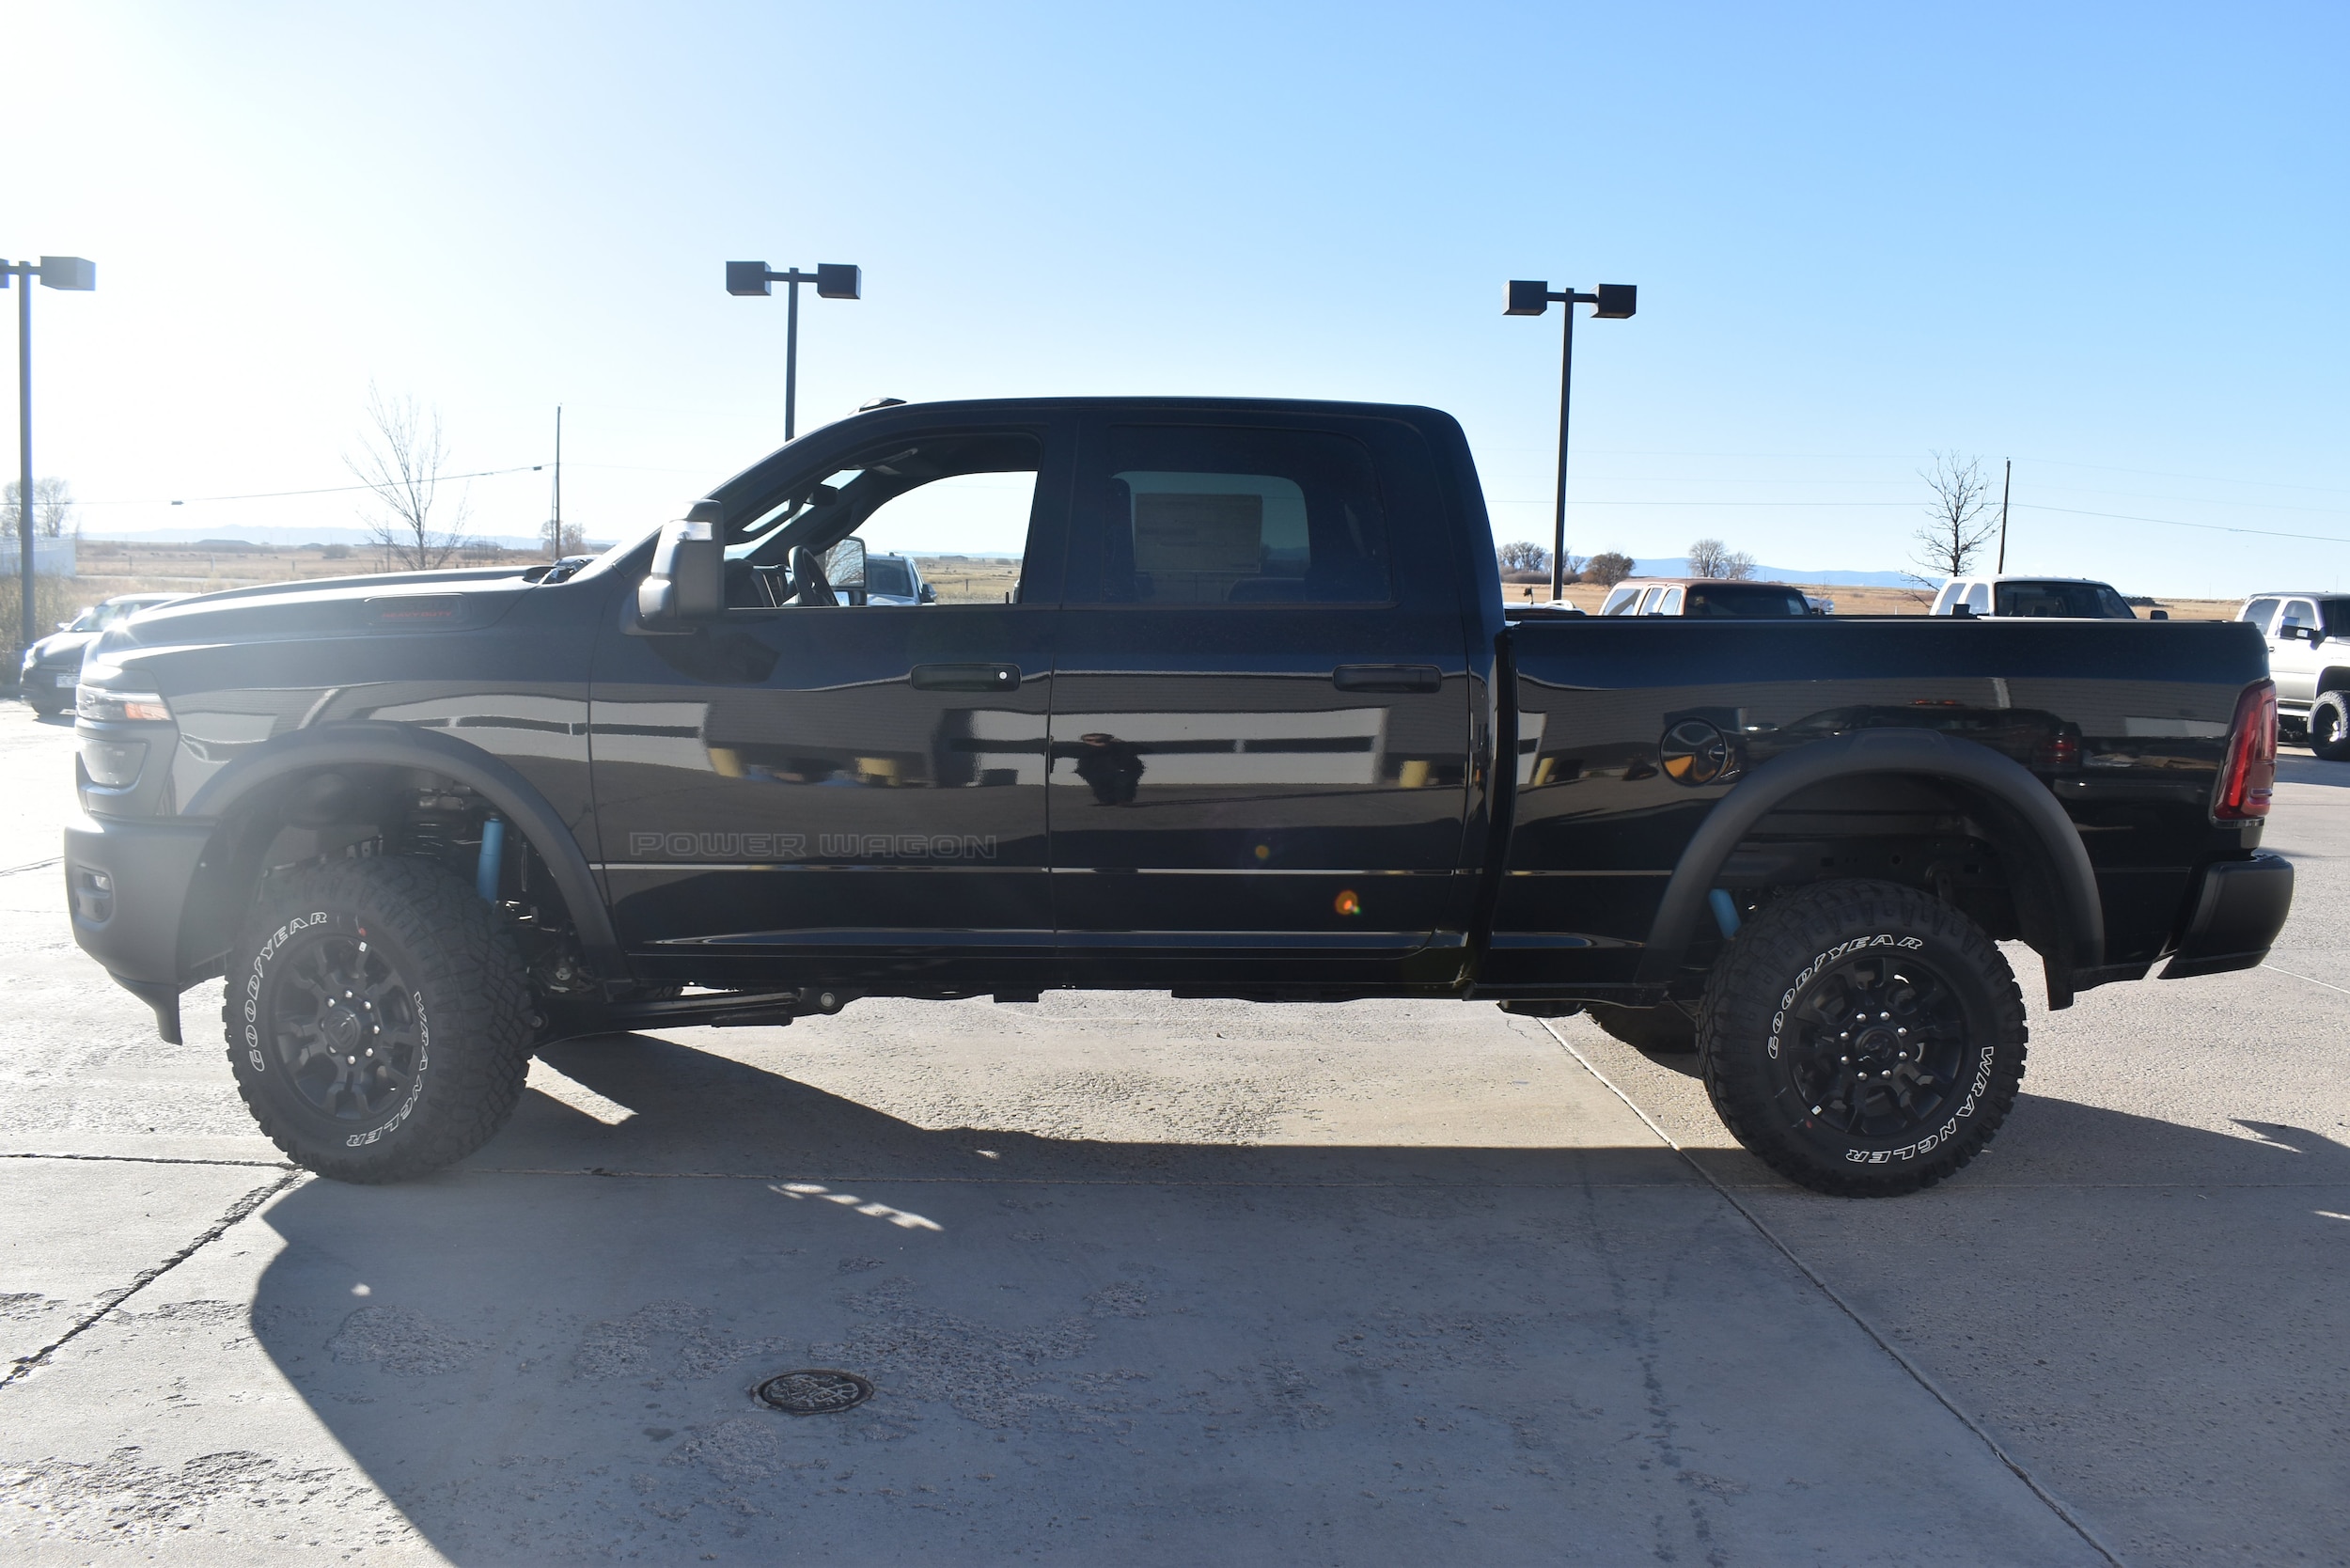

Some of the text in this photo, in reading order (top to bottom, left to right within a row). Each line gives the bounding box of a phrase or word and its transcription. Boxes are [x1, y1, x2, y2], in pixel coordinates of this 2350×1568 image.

[629, 832, 997, 858] POWER WAGON
[243, 911, 328, 1073] GOODYEAR
[1767, 933, 1923, 1060] GOODYEAR
[346, 991, 430, 1148] WRANGLER
[1845, 1044, 1994, 1165] WRANGLER
